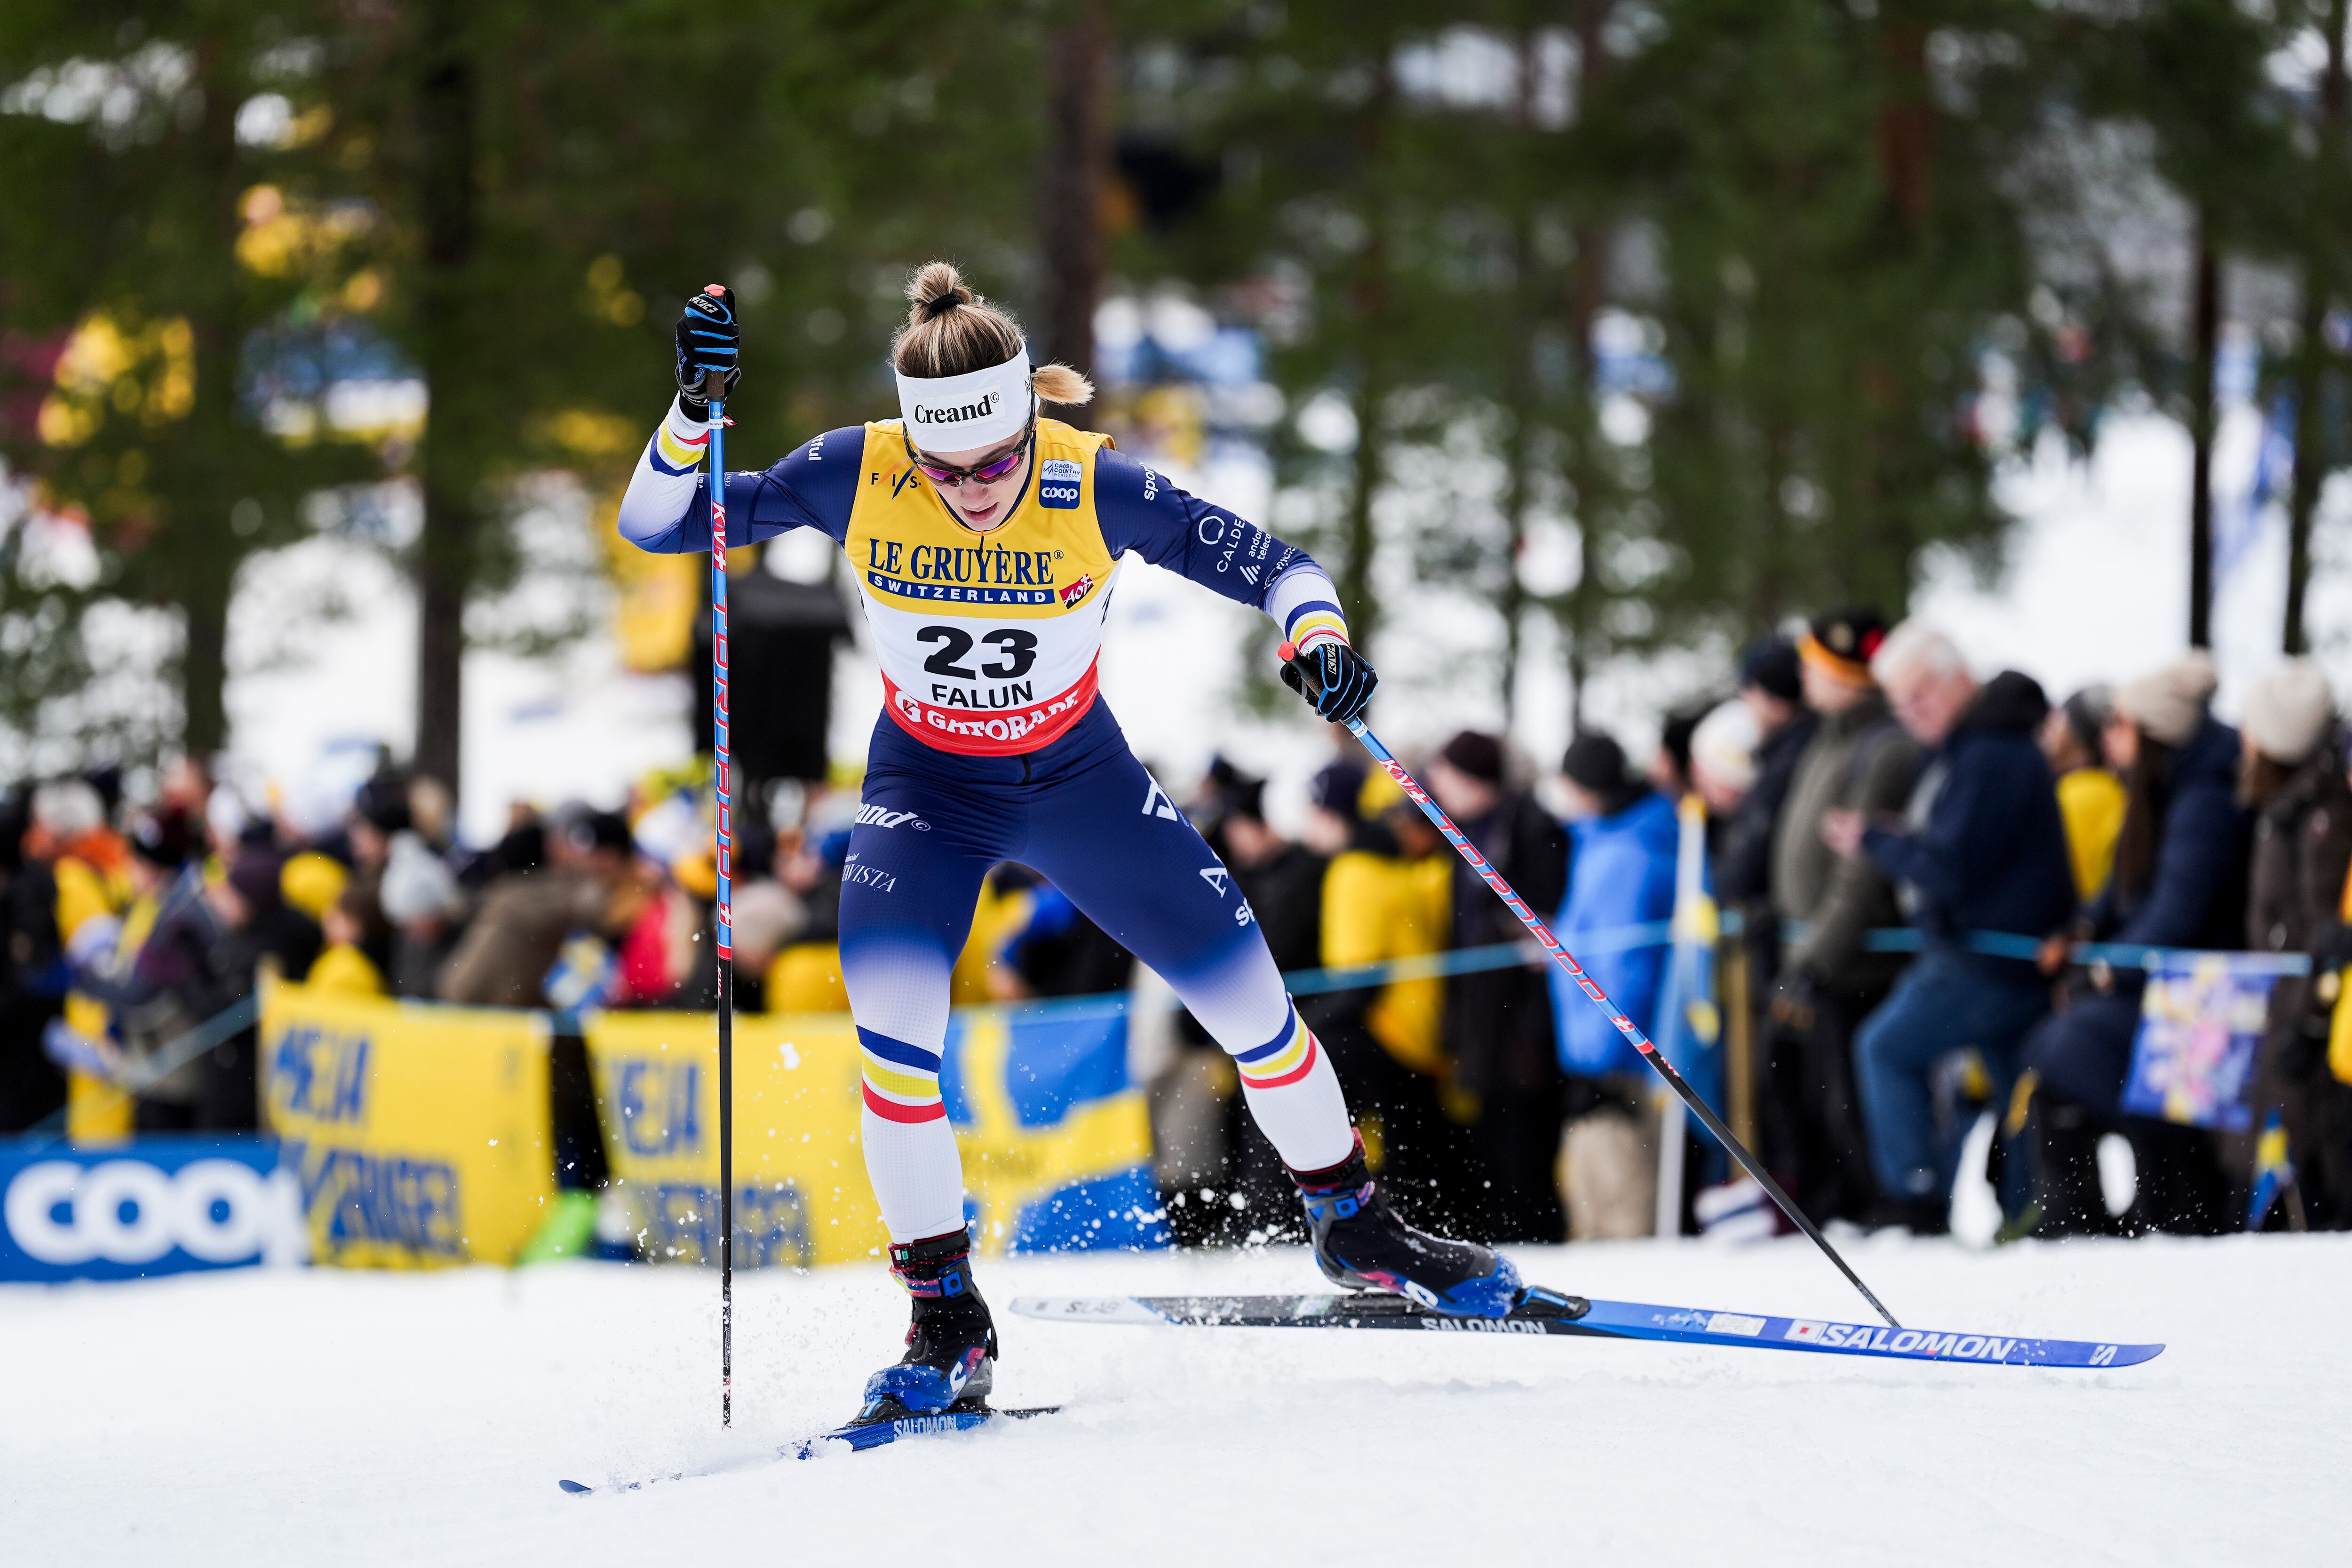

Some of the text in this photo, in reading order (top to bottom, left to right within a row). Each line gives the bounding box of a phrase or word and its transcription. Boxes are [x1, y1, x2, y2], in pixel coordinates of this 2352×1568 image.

[809, 432, 825, 461] tful
[1041, 487, 1078, 502] coop
[868, 538, 903, 574] LE
[1216, 518, 1246, 573] CALDE
[1248, 527, 1263, 557] andor
[1257, 533, 1272, 560] teleco
[874, 575, 1046, 603] SWITZERLAND
[916, 626, 1038, 680] 23
[932, 680, 1033, 708] FALUN
[927, 689, 1079, 741] GATORADE
[1421, 1318, 1548, 1334] SALOMON
[1820, 1324, 2017, 1361] SALOMON
[894, 1415, 957, 1441] SALOMON
